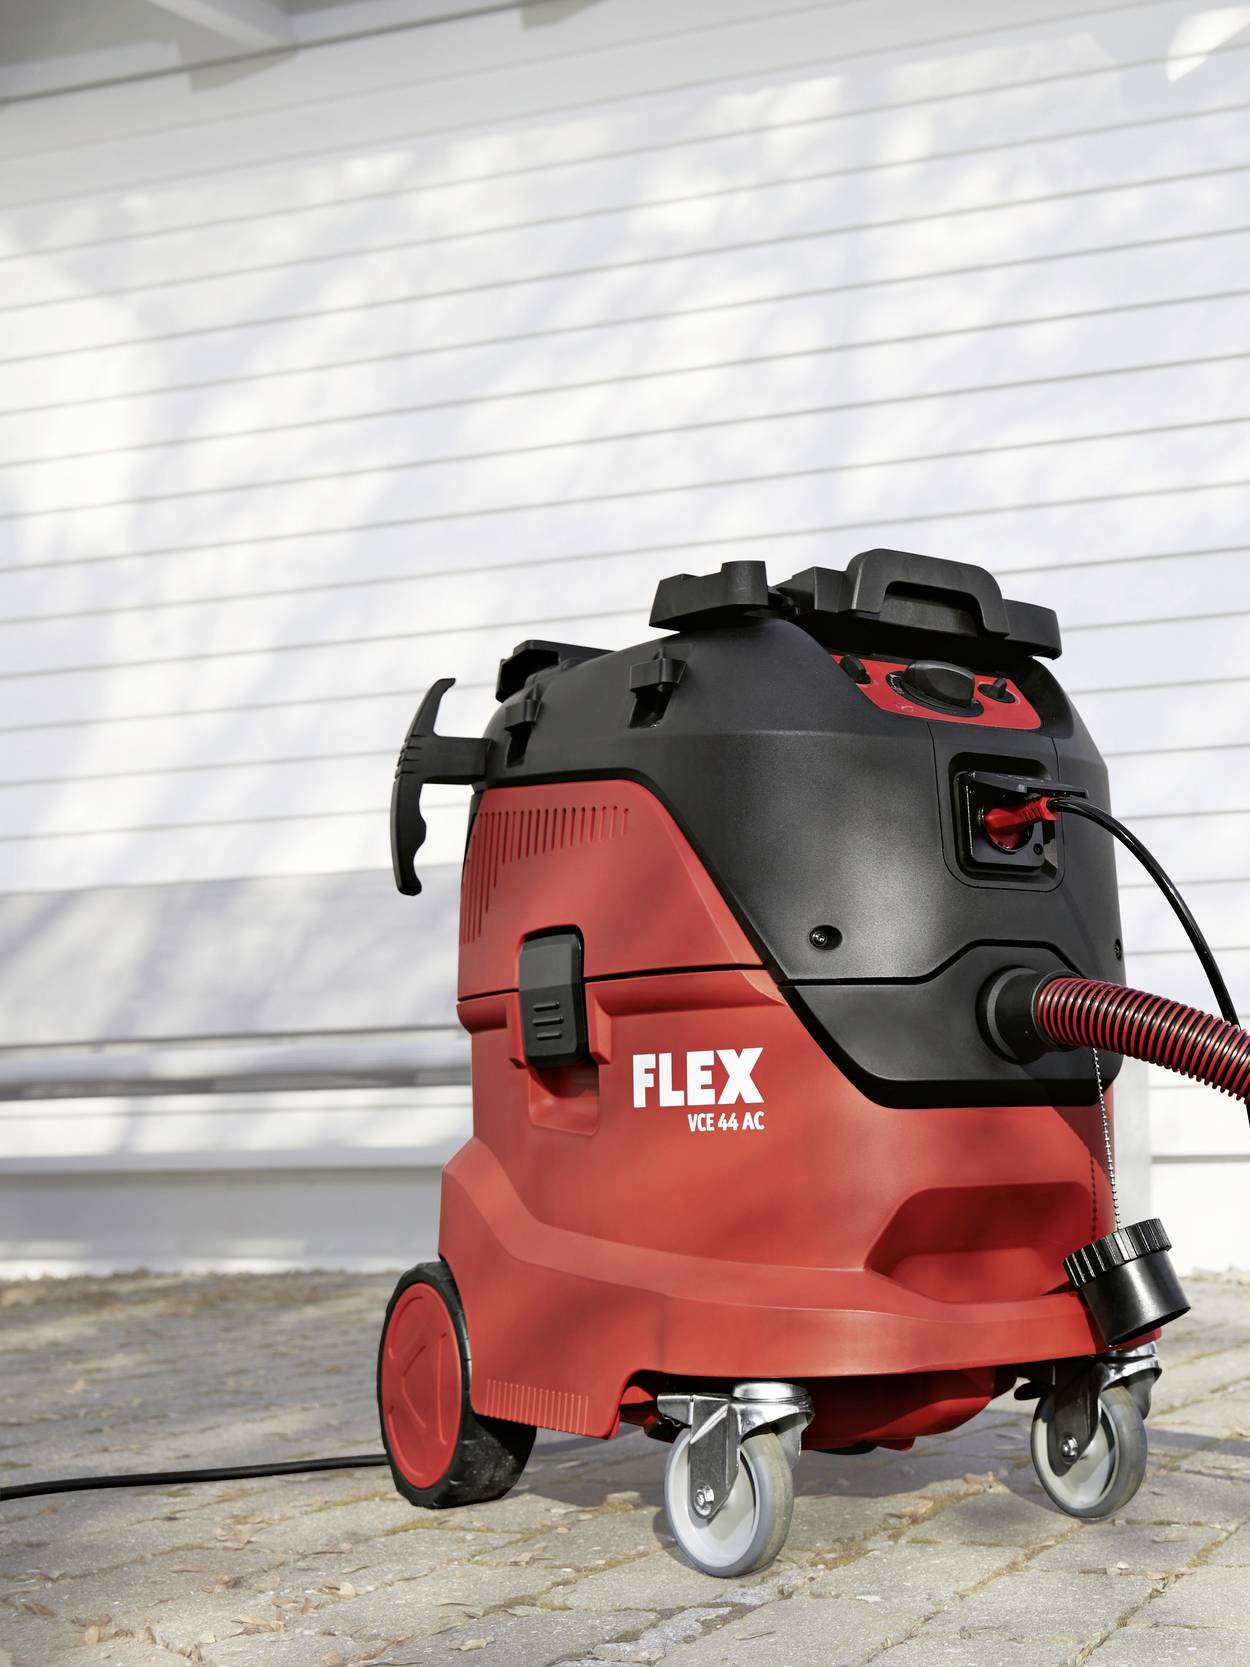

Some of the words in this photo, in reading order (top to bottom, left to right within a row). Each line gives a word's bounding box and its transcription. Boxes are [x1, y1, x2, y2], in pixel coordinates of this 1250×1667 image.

[633, 1047, 765, 1108] FLEX
[687, 1112, 715, 1132] VCE
[717, 1112, 739, 1131] 44
[741, 1110, 766, 1131] AC
